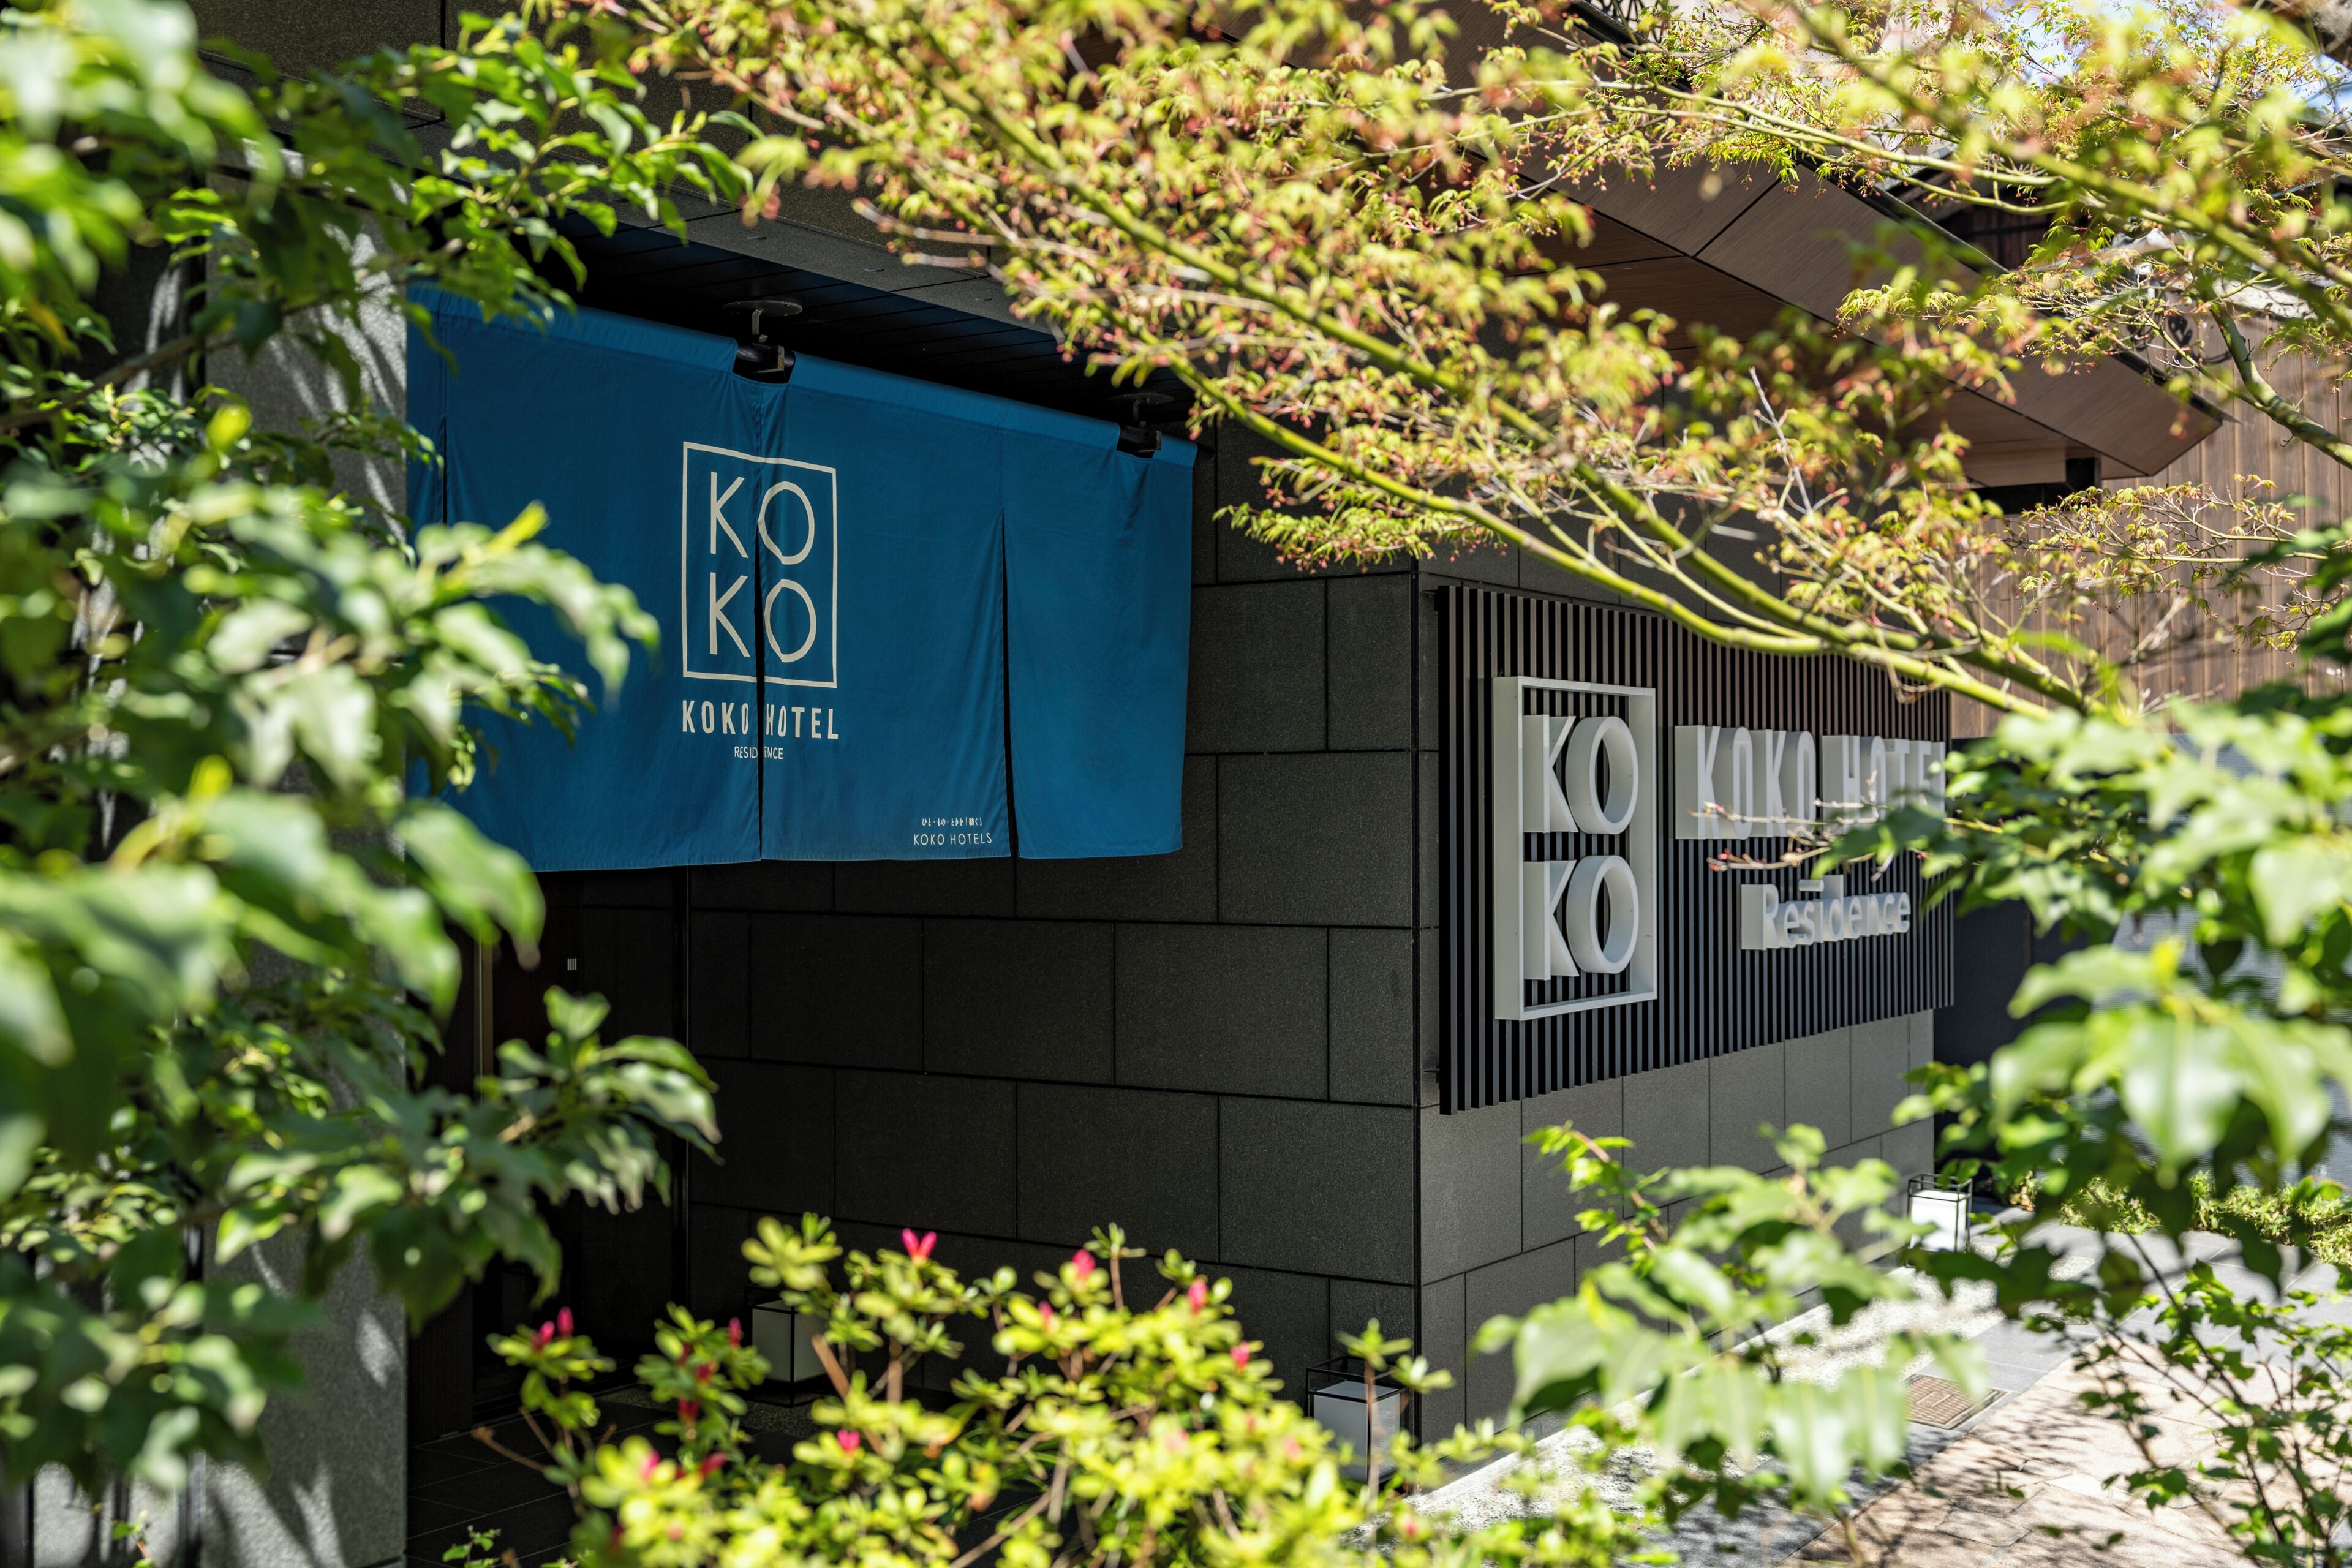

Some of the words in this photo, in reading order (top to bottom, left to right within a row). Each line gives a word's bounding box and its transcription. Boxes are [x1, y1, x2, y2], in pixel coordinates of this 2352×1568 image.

[710, 471, 815, 565] KO
[709, 571, 816, 663] KO
[682, 700, 749, 735] KOKO
[766, 703, 839, 739] HOTEL
[734, 746, 783, 760] RESIDENCE
[1523, 714, 1639, 834] KO
[1675, 725, 1816, 840] KOKO
[914, 834, 945, 846] KOKO
[950, 832, 992, 845] HOTELS
[1523, 855, 1640, 980] KO
[1741, 875, 1911, 950] Residence
